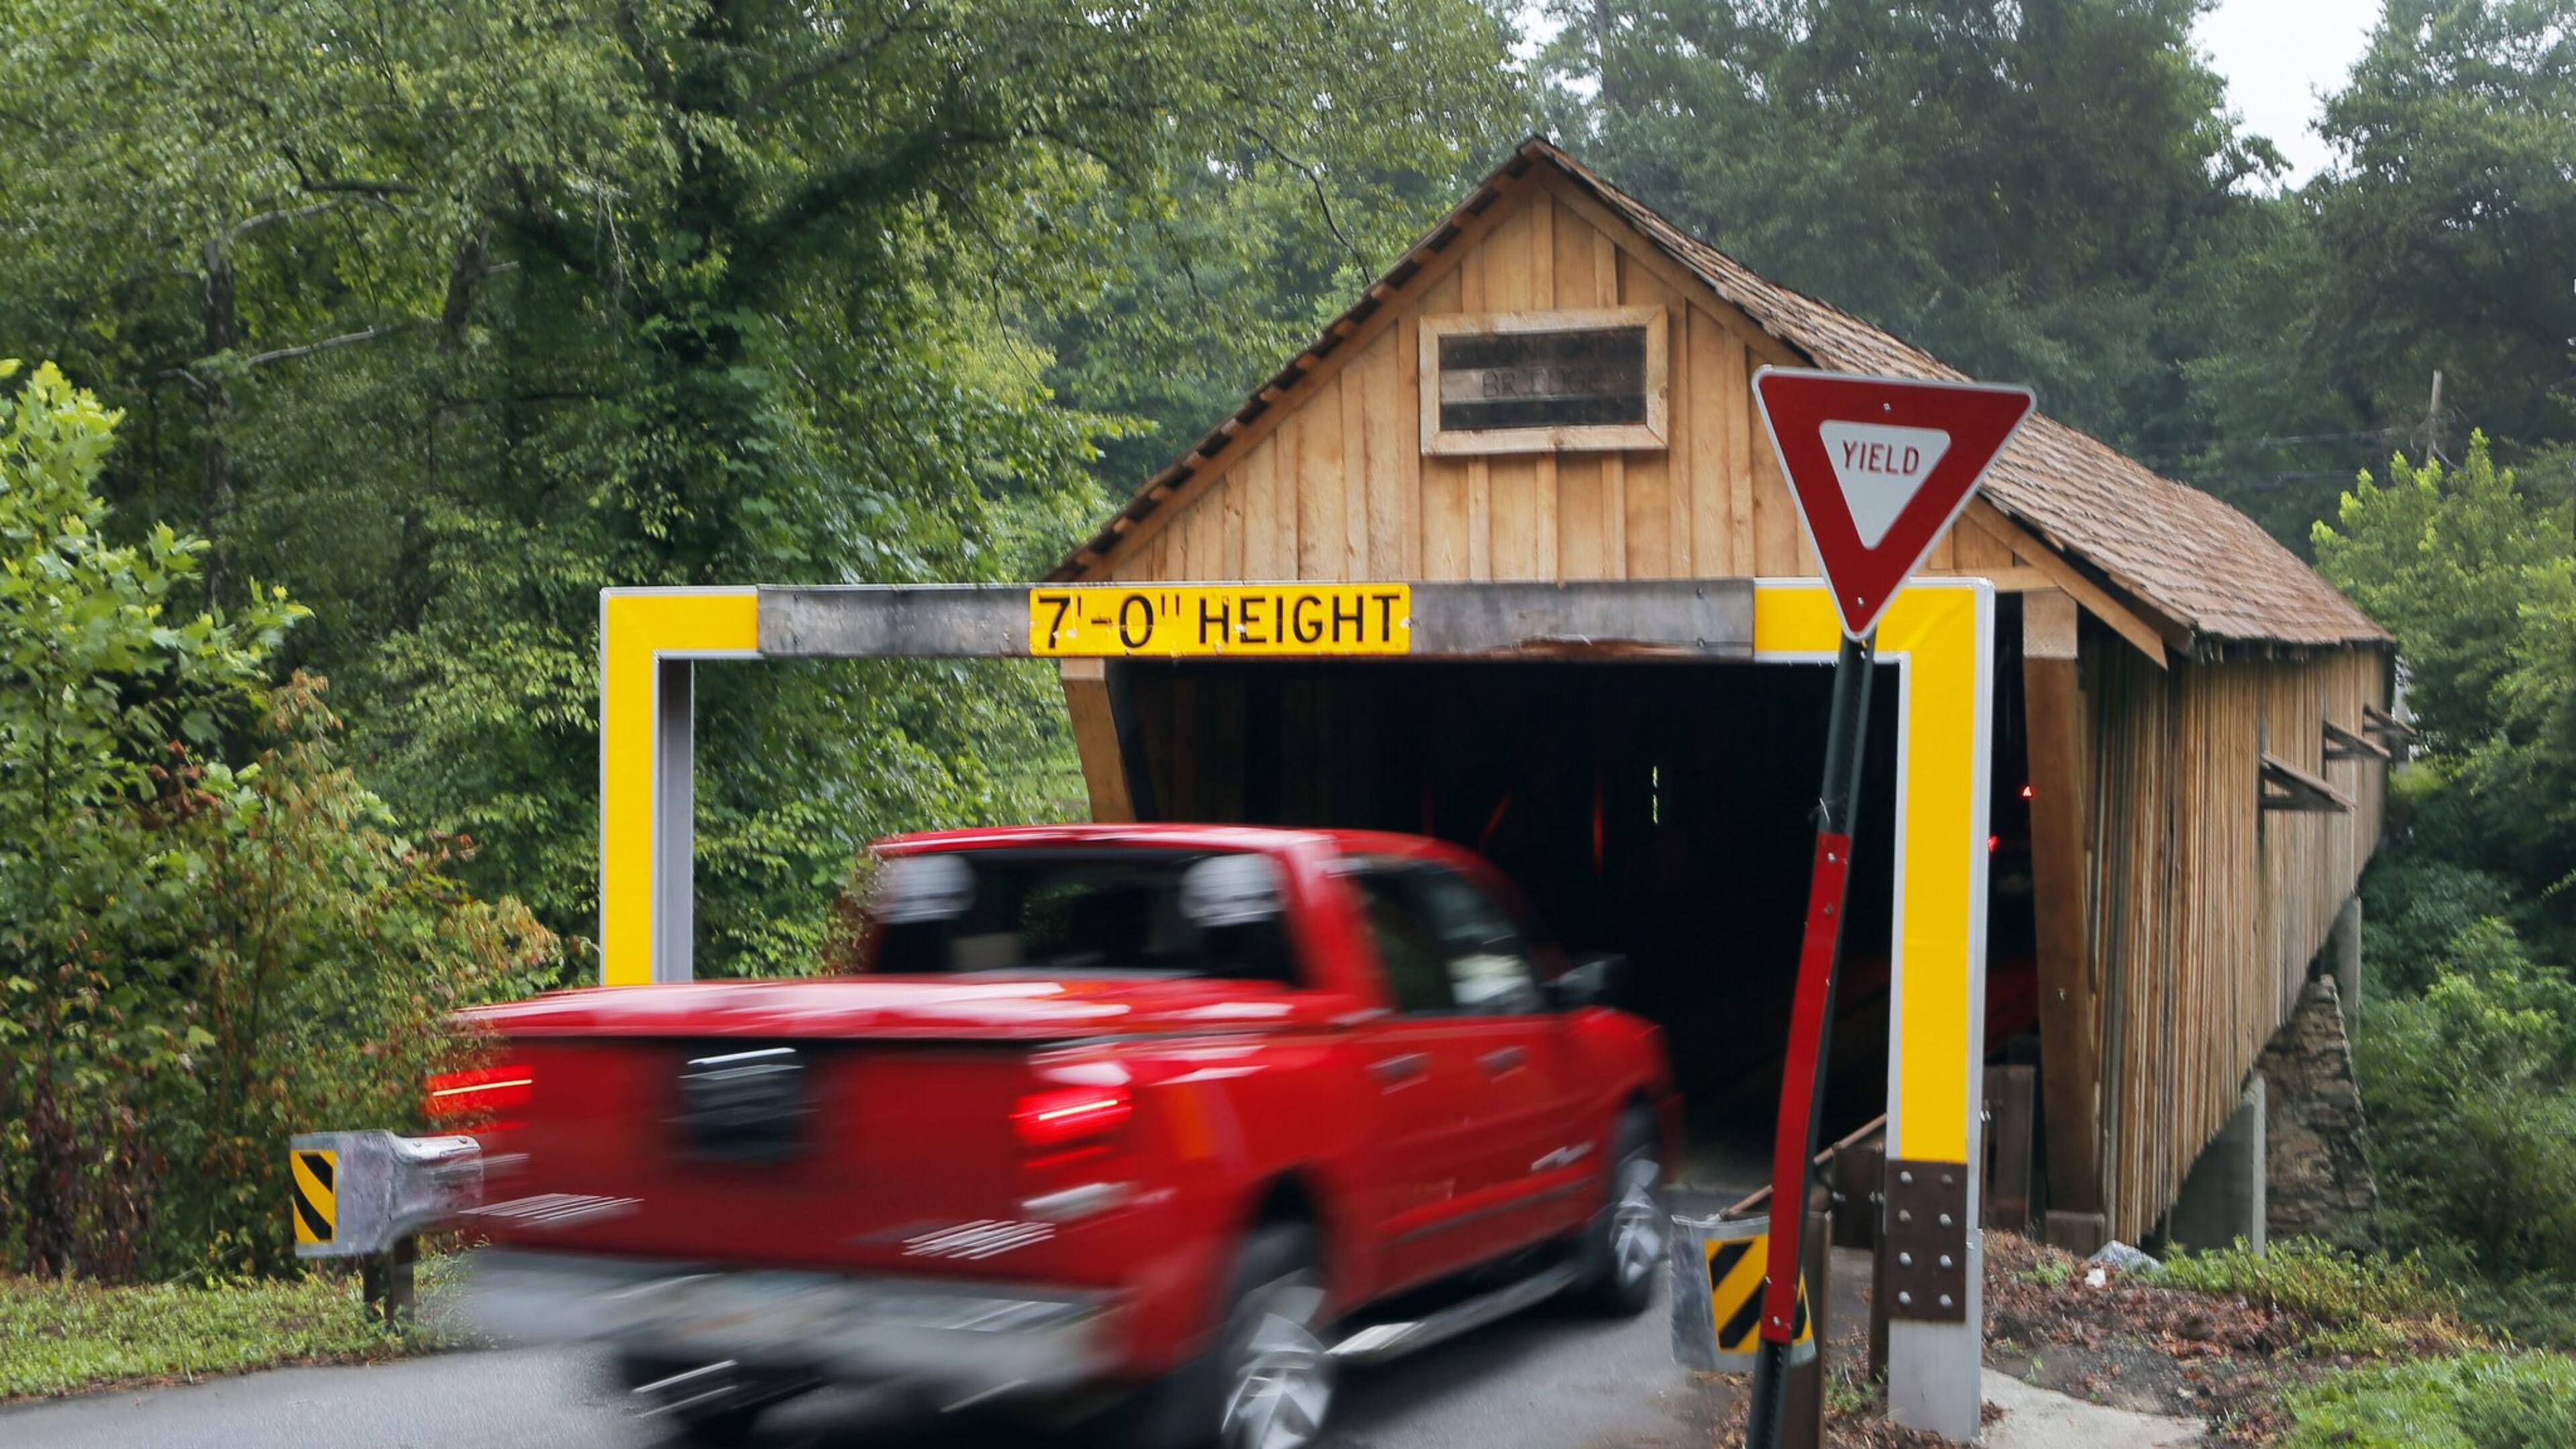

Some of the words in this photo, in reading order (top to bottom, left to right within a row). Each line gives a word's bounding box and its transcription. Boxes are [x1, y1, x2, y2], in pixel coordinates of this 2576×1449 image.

[1483, 368, 1605, 398] BRIDGE
[1843, 440, 1919, 475] YIELD
[1198, 595, 1400, 644] HEIGHT
